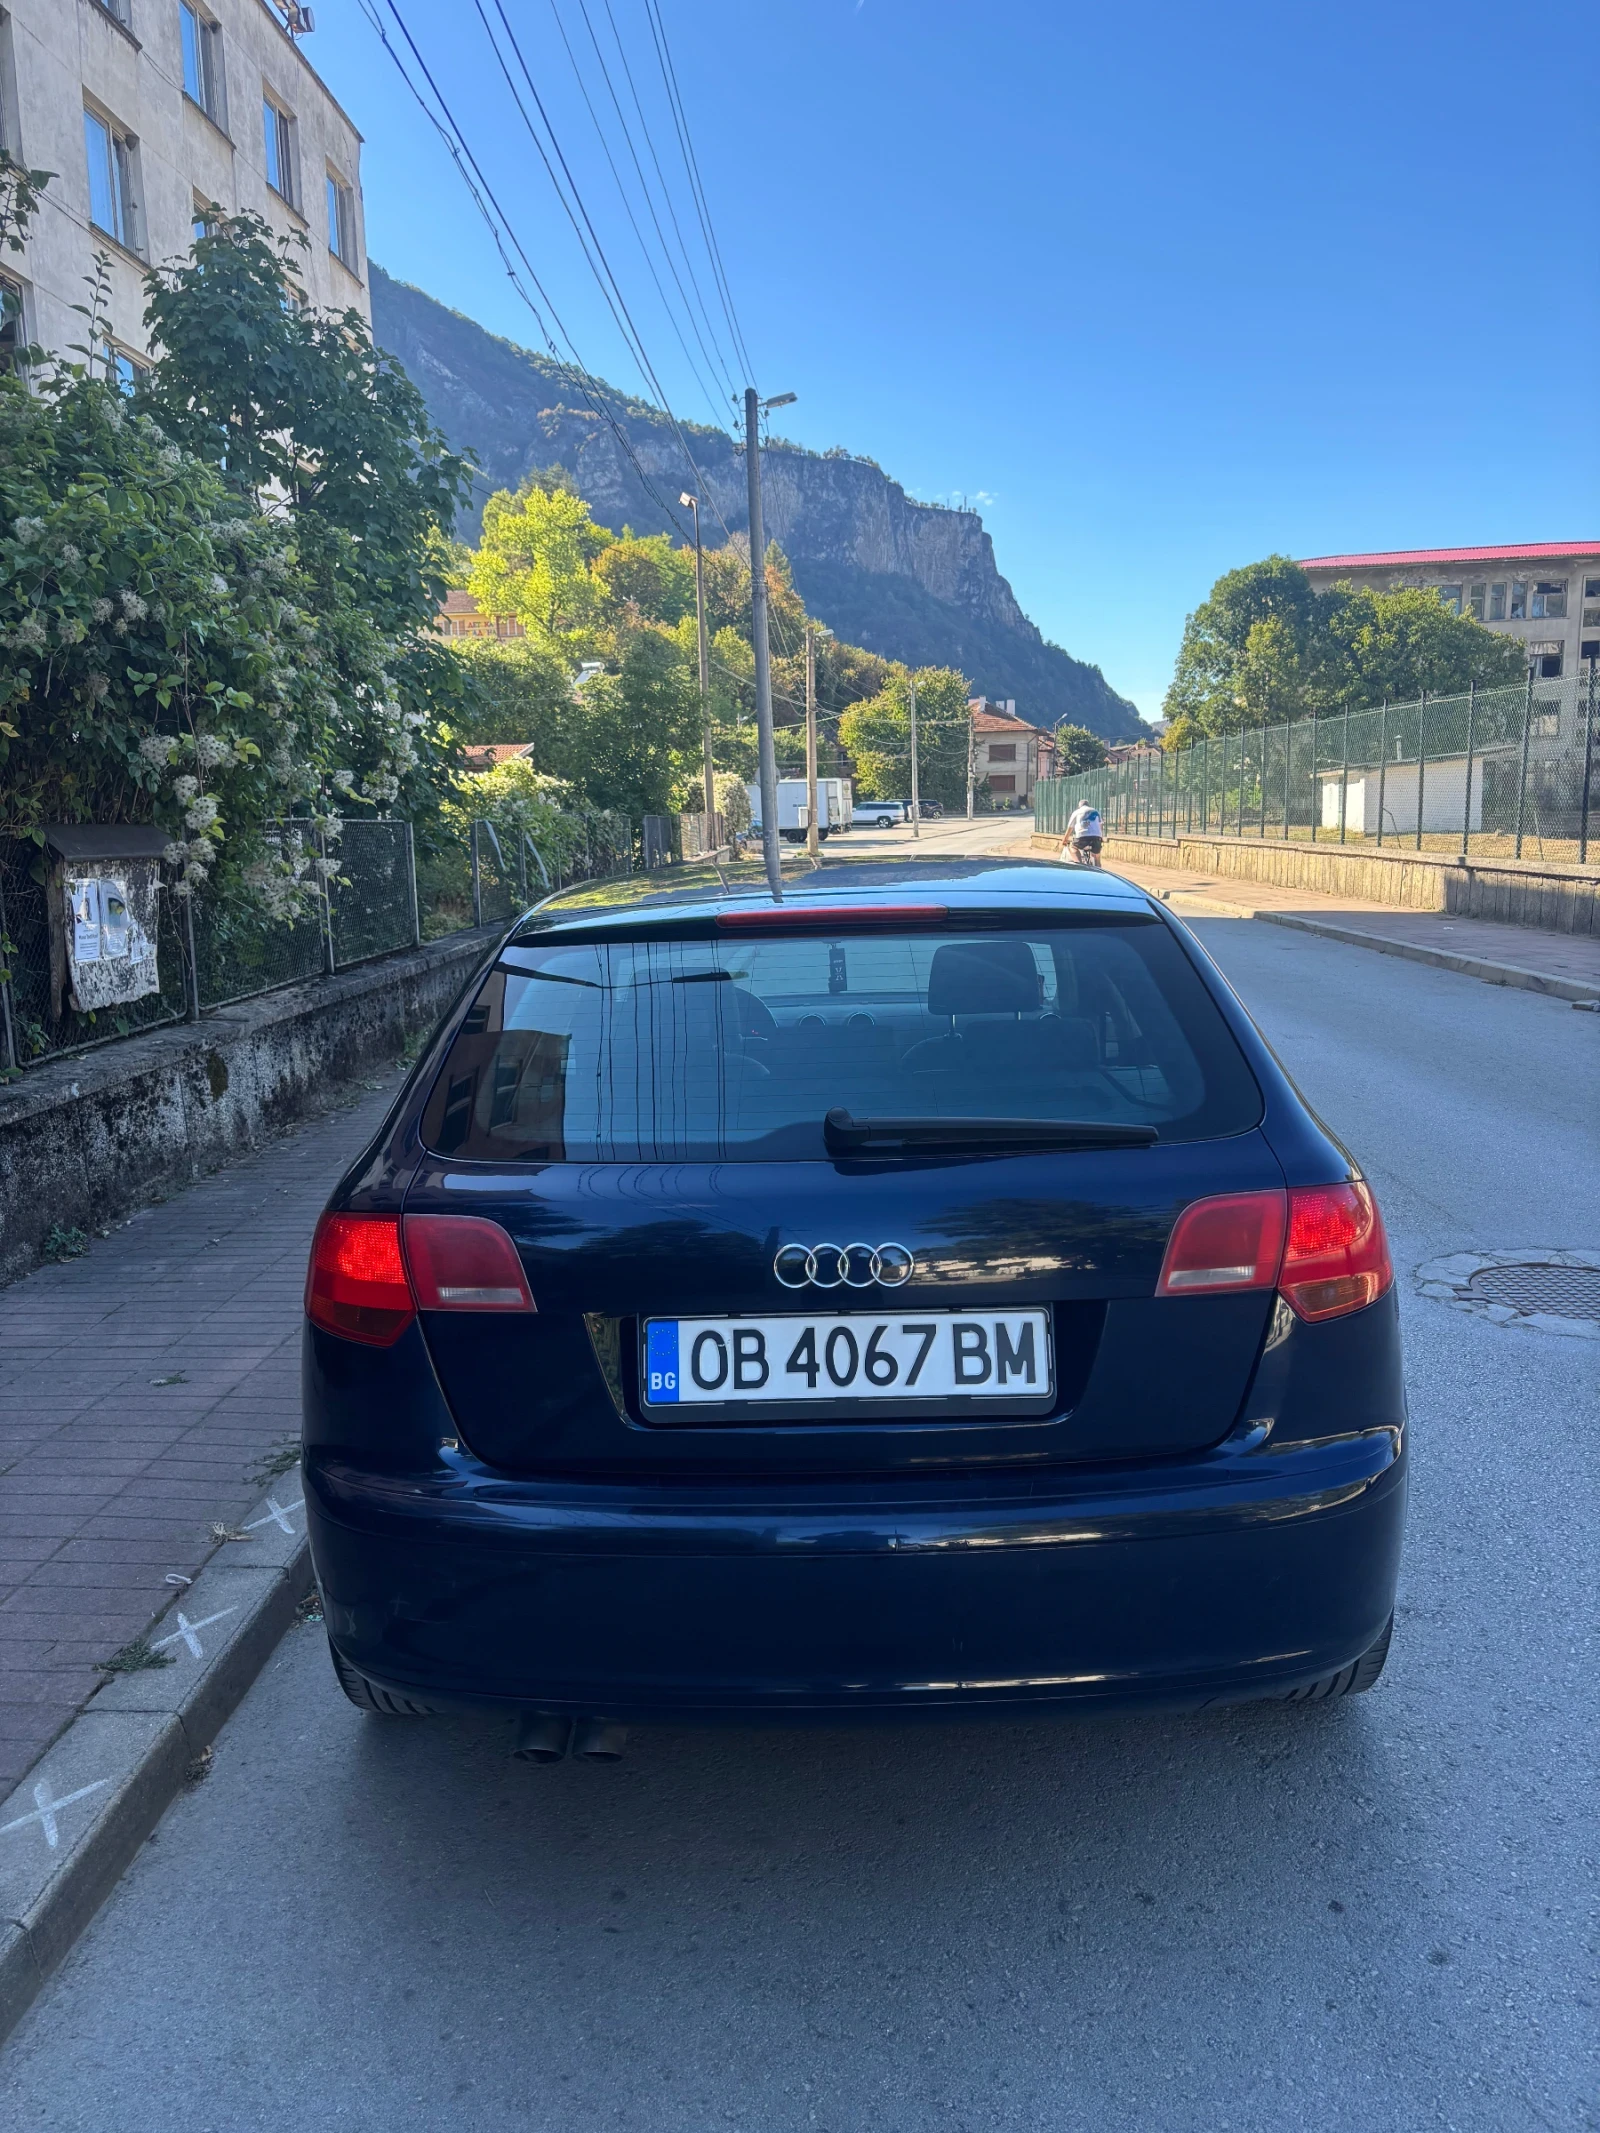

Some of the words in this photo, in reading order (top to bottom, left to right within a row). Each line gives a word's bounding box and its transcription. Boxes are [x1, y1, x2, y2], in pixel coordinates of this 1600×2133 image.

[691, 1329, 769, 1390] OB
[786, 1325, 936, 1388] 4067
[952, 1322, 1036, 1385] BM
[651, 1372, 676, 1390] BG
